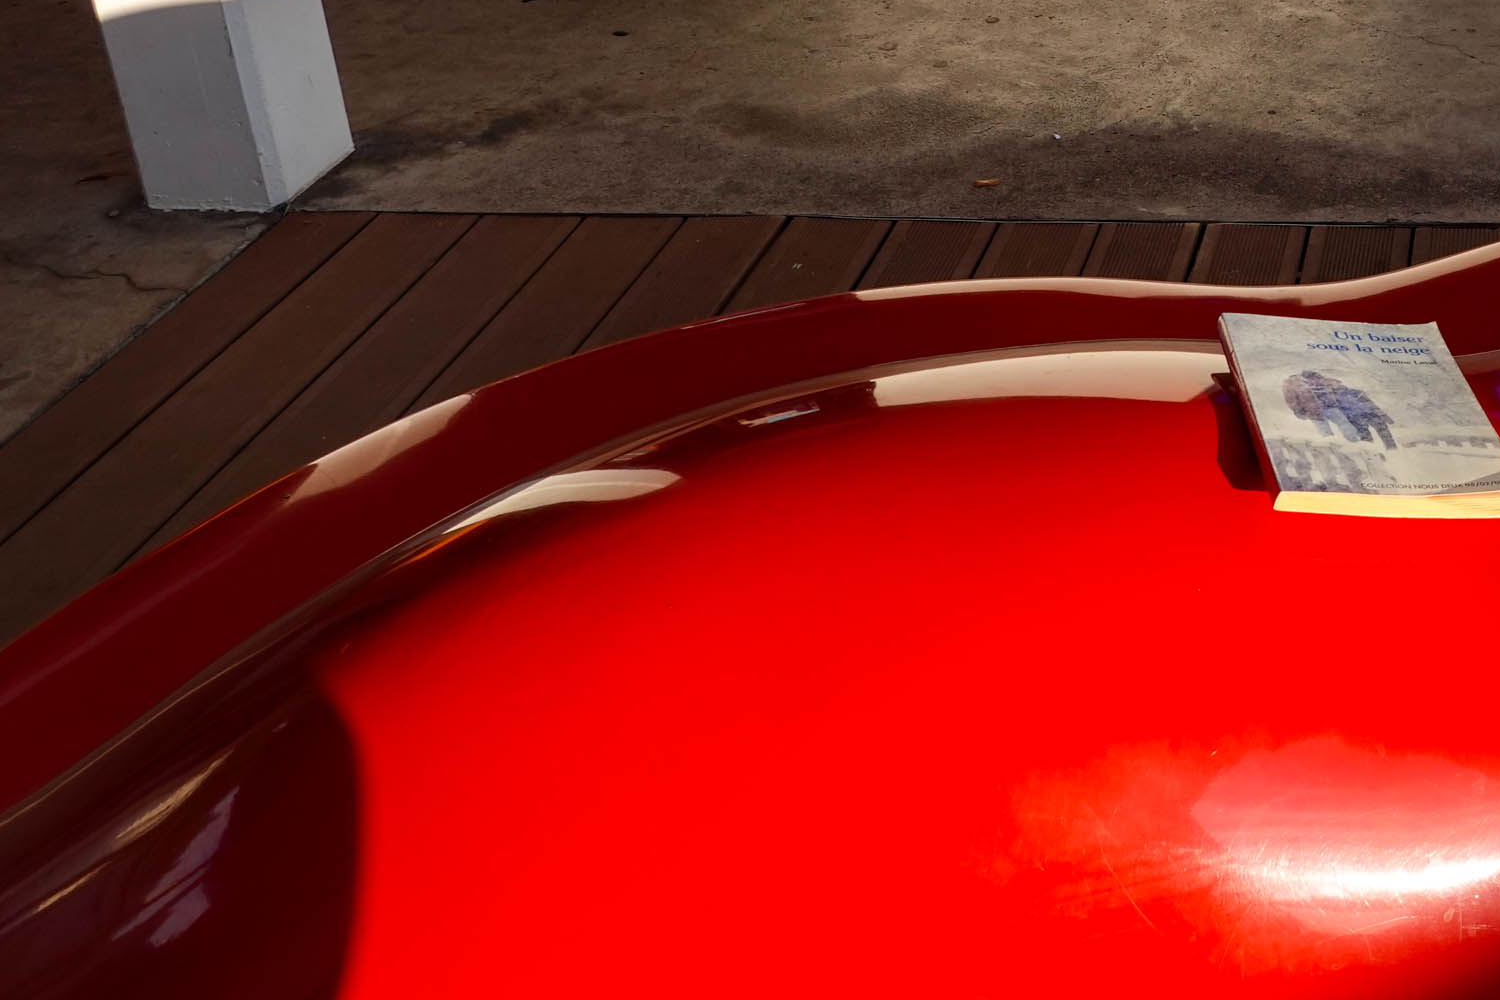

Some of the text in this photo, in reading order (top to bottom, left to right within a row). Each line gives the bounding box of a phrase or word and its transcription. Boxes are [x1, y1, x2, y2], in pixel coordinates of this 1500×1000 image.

[1333, 331, 1424, 344] Un baiser
[1306, 343, 1431, 356] sous la neige
